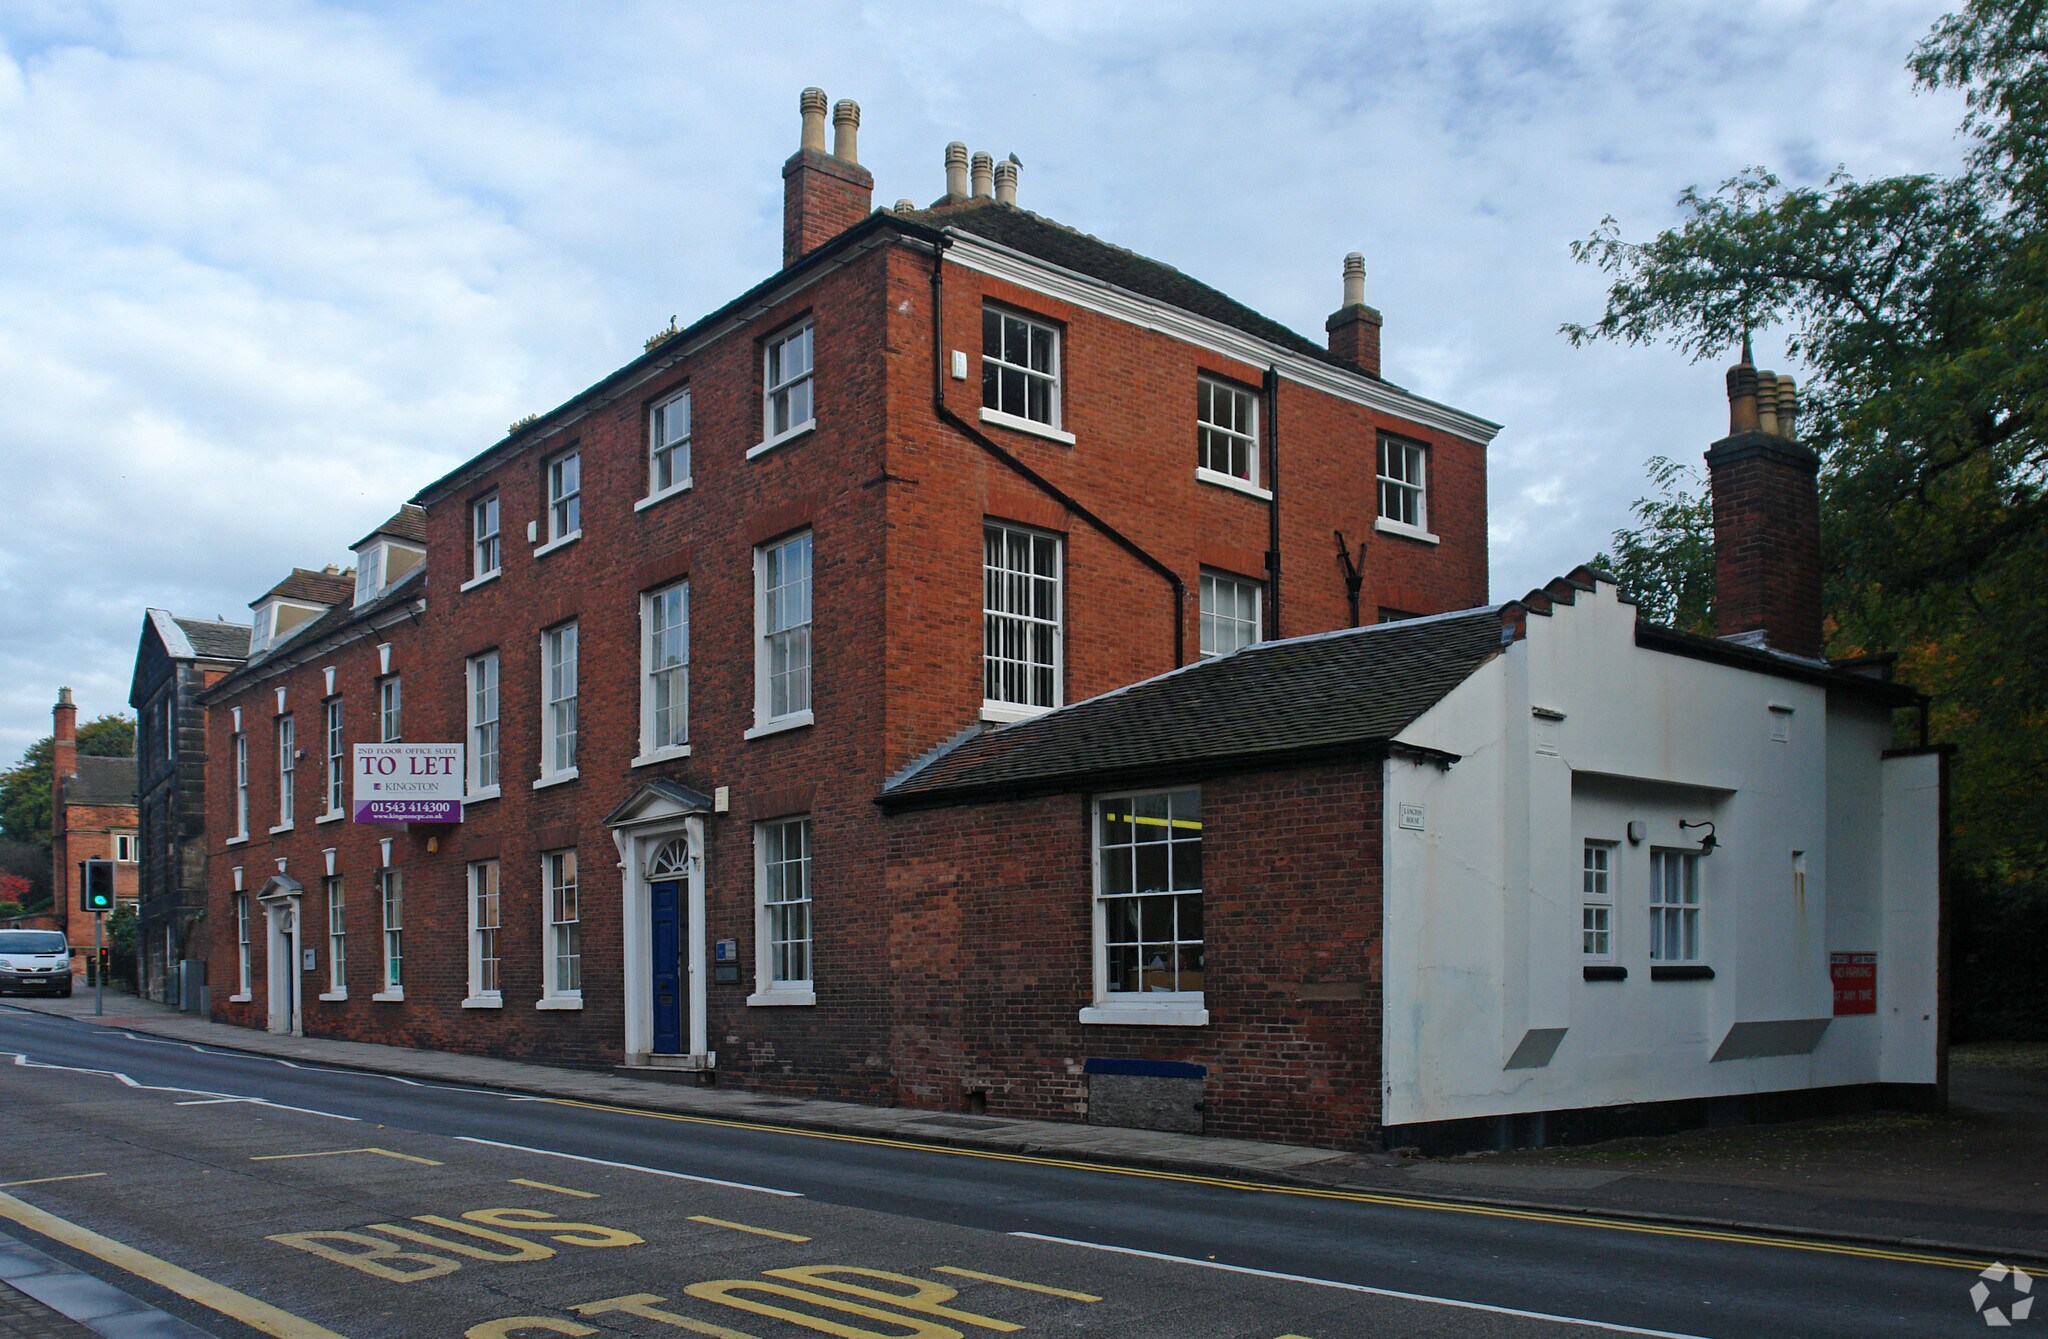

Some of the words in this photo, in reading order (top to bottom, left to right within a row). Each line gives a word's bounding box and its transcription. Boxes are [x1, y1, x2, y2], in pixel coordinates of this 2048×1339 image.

[359, 756, 397, 775] TO
[409, 756, 456, 775] LET
[385, 782, 439, 791] KINGSTON
[371, 802, 406, 812] 01543
[408, 802, 450, 812] 414300
[1833, 966, 1844, 978] NO
[1845, 966, 1872, 977] PARKING
[1843, 990, 1856, 1001] ANY
[1858, 989, 1873, 1000] TIME
[264, 1208, 646, 1284] BUS
